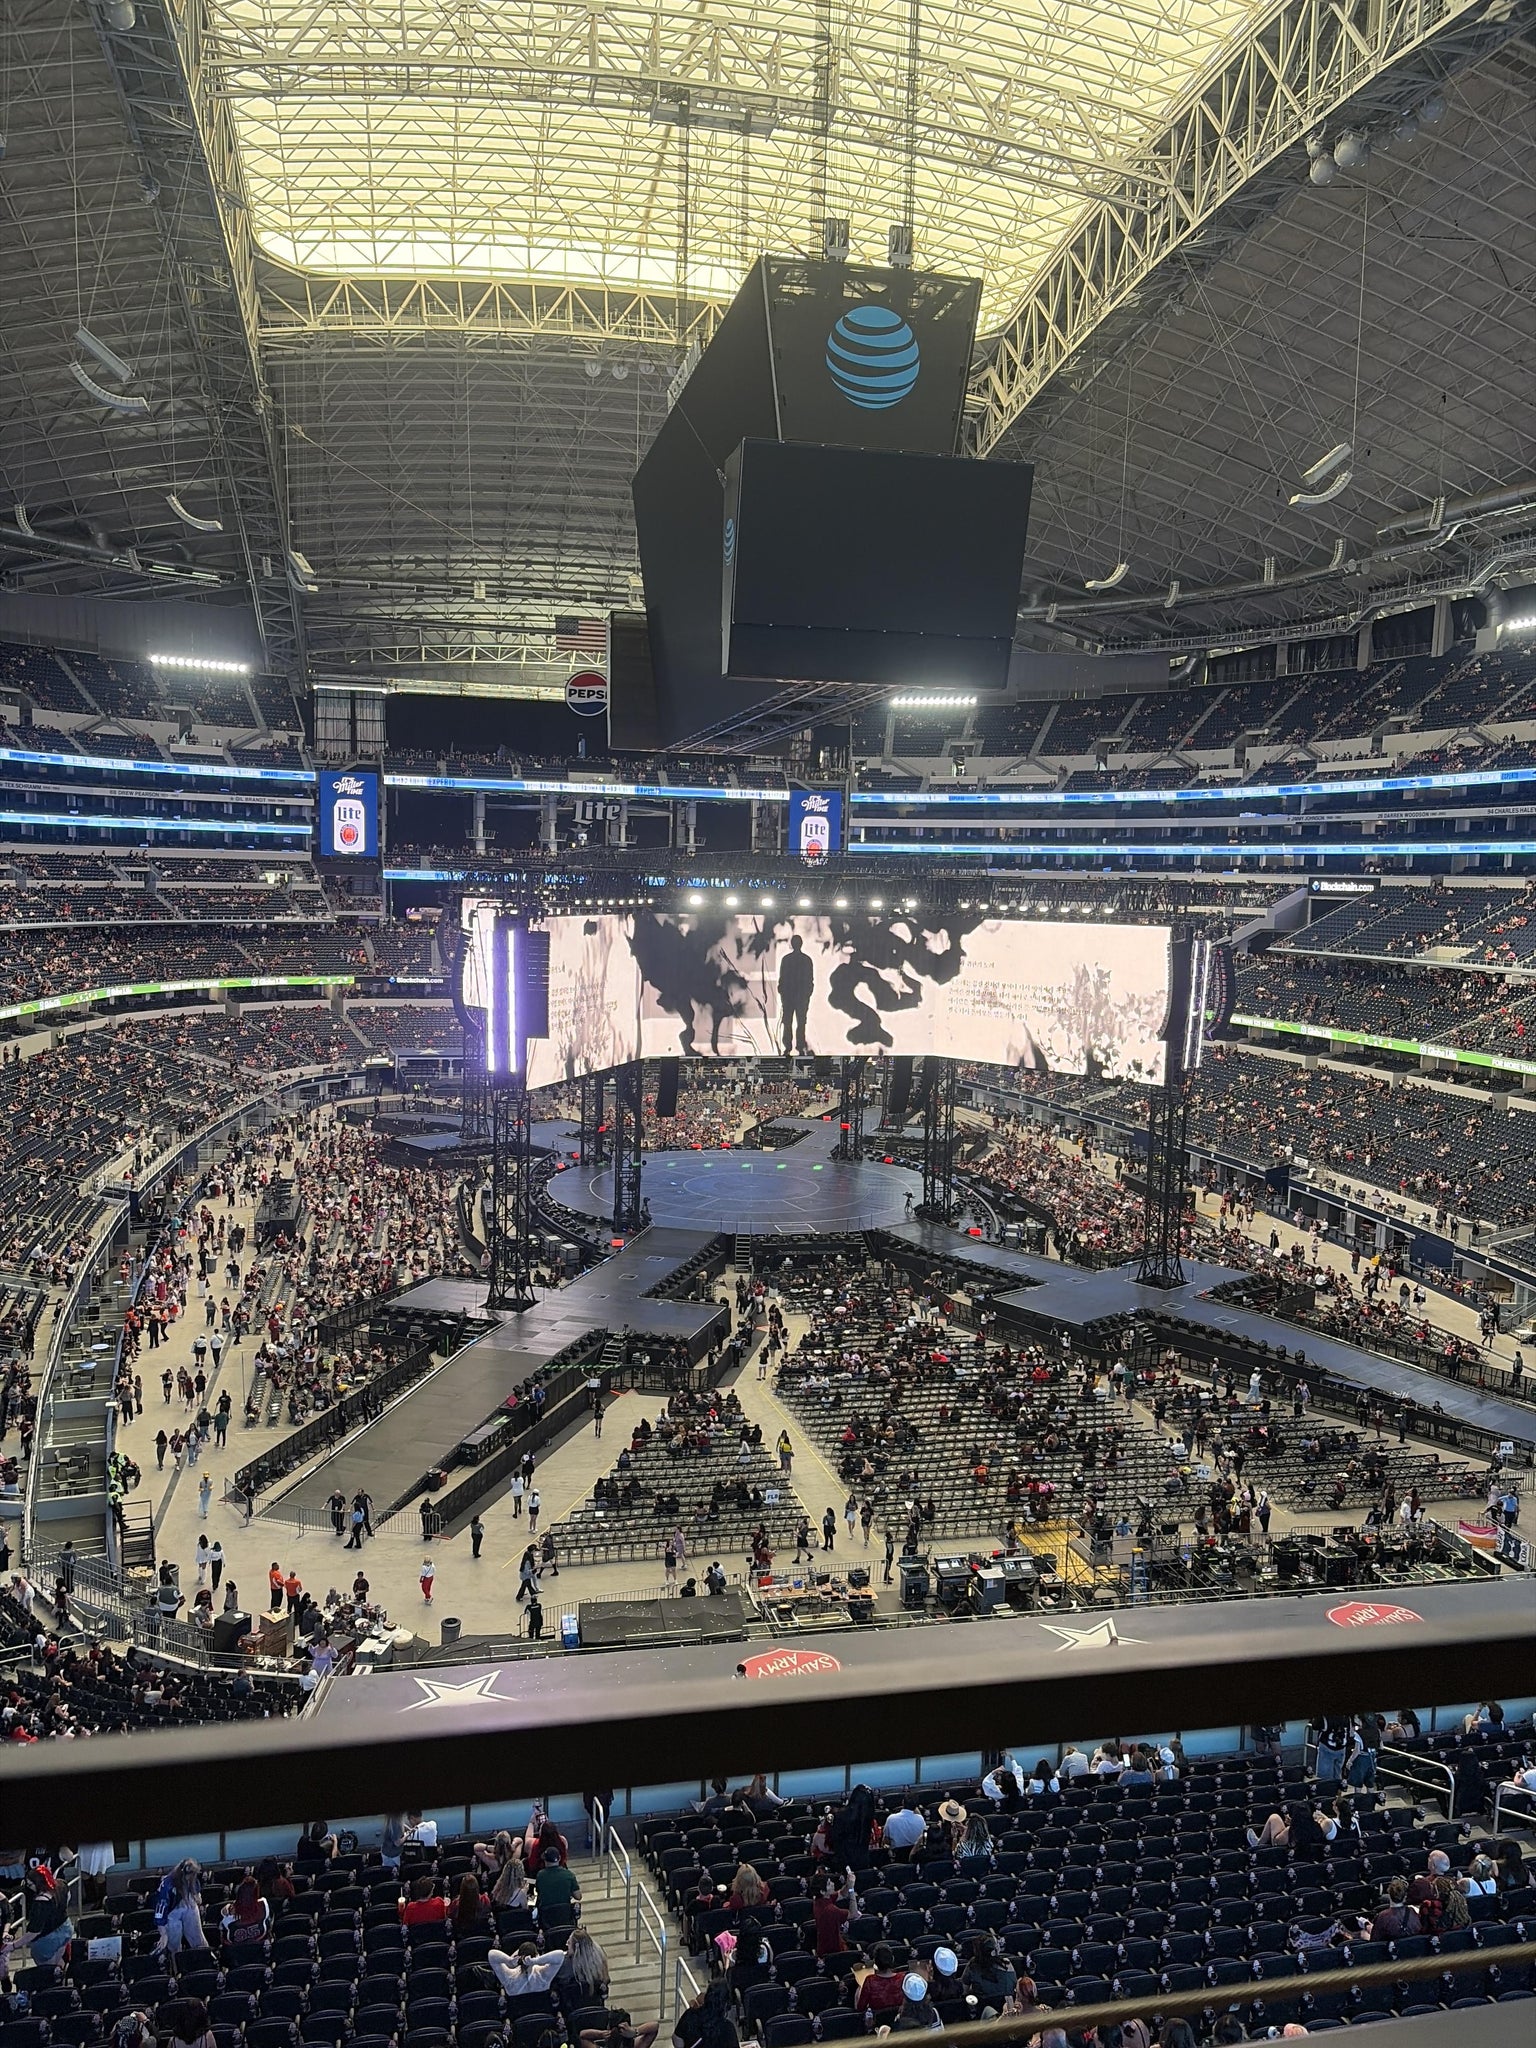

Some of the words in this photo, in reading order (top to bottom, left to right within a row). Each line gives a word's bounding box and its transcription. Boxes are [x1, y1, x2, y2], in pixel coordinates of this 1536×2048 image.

[333, 780, 365, 794] Miller
[337, 806, 361, 822] Lite
[572, 800, 621, 825] Lite
[805, 822, 826, 838] Lite
[1320, 881, 1375, 892] Blockchain.com
[396, 976, 444, 984] Blockchain.com
[1345, 1605, 1380, 1627] ARMY
[757, 1652, 798, 1679] ARMY
